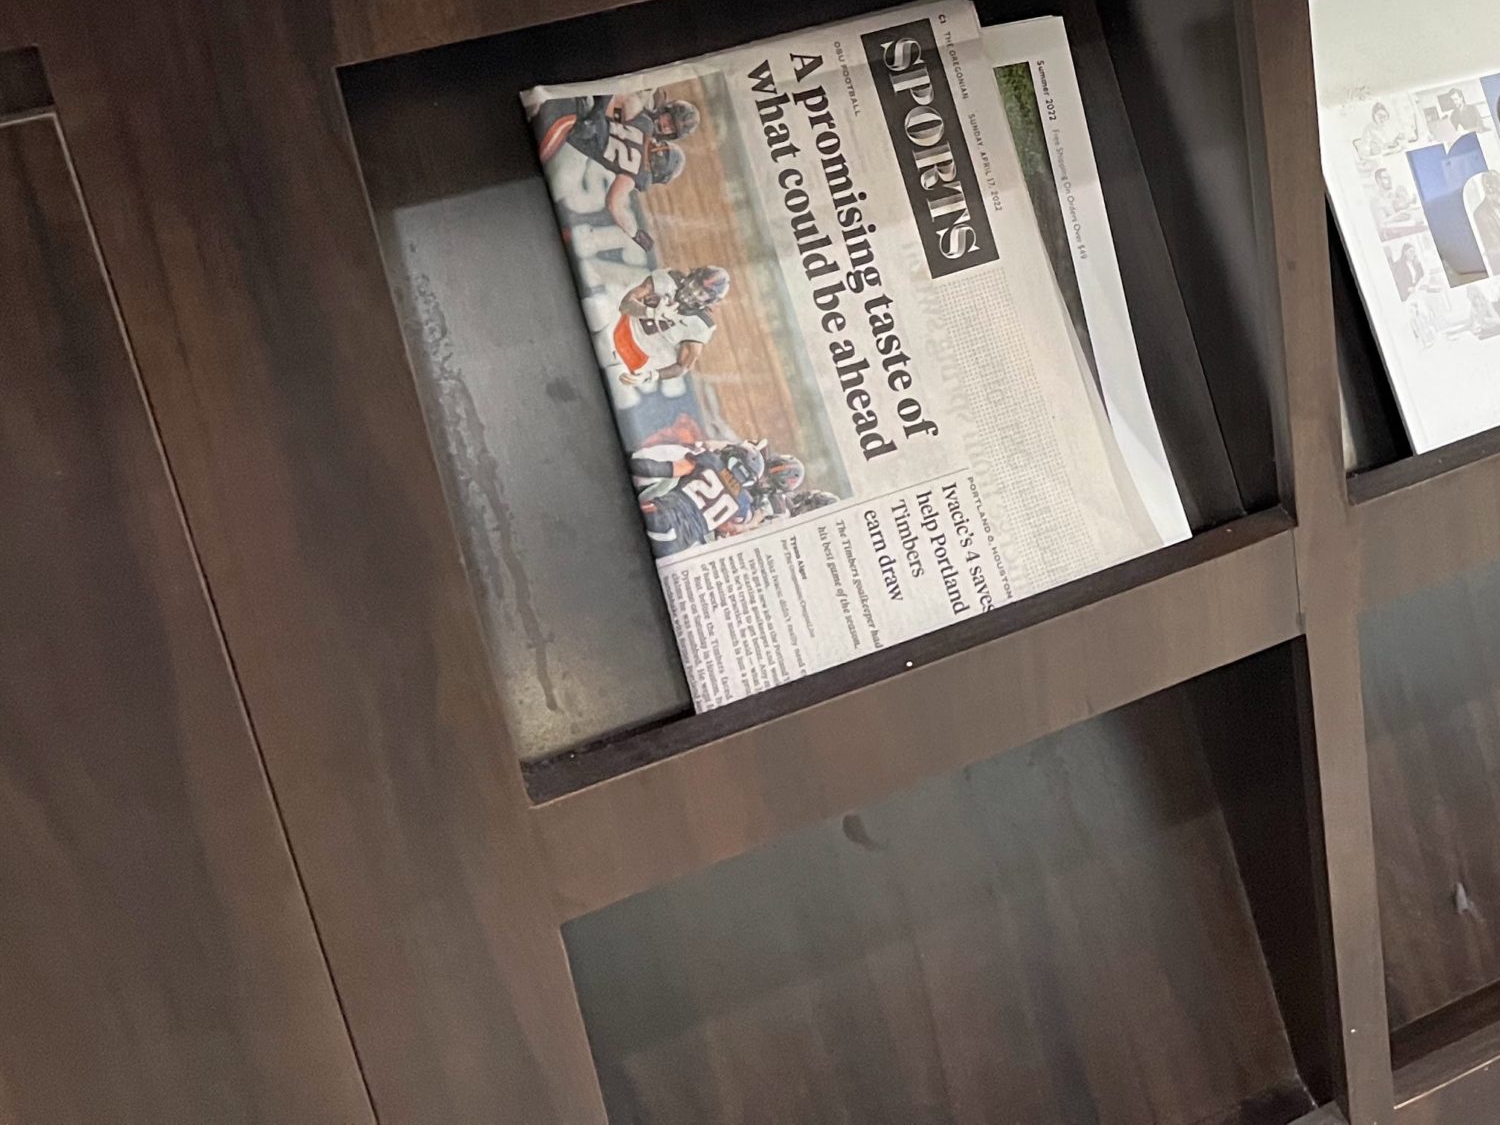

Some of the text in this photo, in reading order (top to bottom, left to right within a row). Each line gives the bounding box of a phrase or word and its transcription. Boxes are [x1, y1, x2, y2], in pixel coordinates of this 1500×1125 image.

[945, 31, 955, 48] THE
[841, 64, 860, 115] FOOTBALL
[948, 50, 968, 99] OREGONIAN
[1037, 60, 1049, 95] Summer
[1045, 99, 1057, 120] 2022
[880, 37, 980, 261] SPORTS
[980, 152, 991, 175] APRIL
[991, 190, 1002, 211] 2022
[748, 61, 896, 459] what could be ahead
[790, 53, 938, 438] A promising taste of
[682, 470, 740, 531] 20
[818, 526, 828, 541] his
[822, 541, 834, 560] best
[864, 510, 903, 600] earn draw
[891, 499, 924, 577] Timbers
[916, 491, 970, 614] help Portland
[942, 483, 994, 613] Ivacic's 4 saves
[968, 476, 991, 533] PORTLAND
[992, 547, 1013, 599] HOUSTON
[827, 562, 842, 586] game
[836, 520, 884, 649] The Timbers goalkeeper had
[836, 588, 848, 597] of
[840, 599, 850, 613] the
